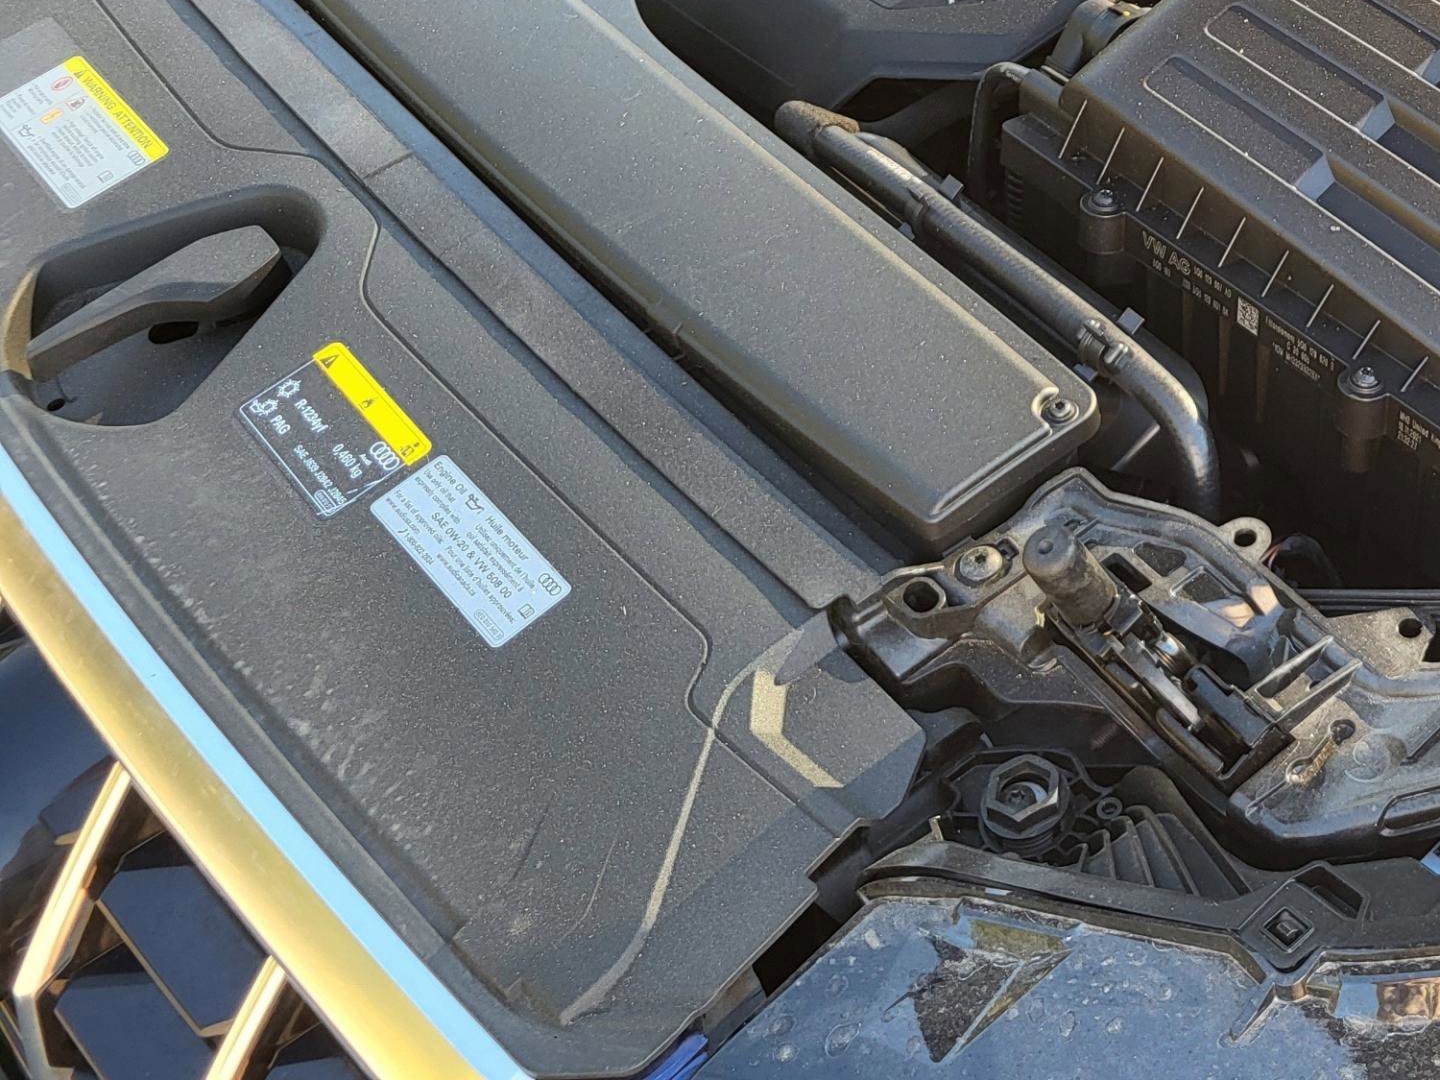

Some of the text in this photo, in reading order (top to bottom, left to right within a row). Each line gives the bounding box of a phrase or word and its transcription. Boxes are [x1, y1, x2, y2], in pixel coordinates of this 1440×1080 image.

[82, 75, 116, 110] WARNING
[113, 109, 152, 148] ATTENTION
[1143, 231, 1166, 259] VW
[1168, 251, 1191, 275] AG
[269, 414, 290, 435] PAG
[293, 444, 308, 458] SAE
[293, 398, 363, 478] R-1234yf 0,460 kg
[414, 475, 436, 496] expressly
[429, 475, 443, 488] only
[445, 491, 456, 503] that
[433, 461, 467, 495] Engine Oil
[431, 511, 448, 529] SAE
[443, 527, 469, 553] 0W-20
[466, 550, 477, 560] &
[472, 557, 489, 574] VW
[499, 586, 512, 598] 00
[485, 515, 529, 562] Huile moteur
